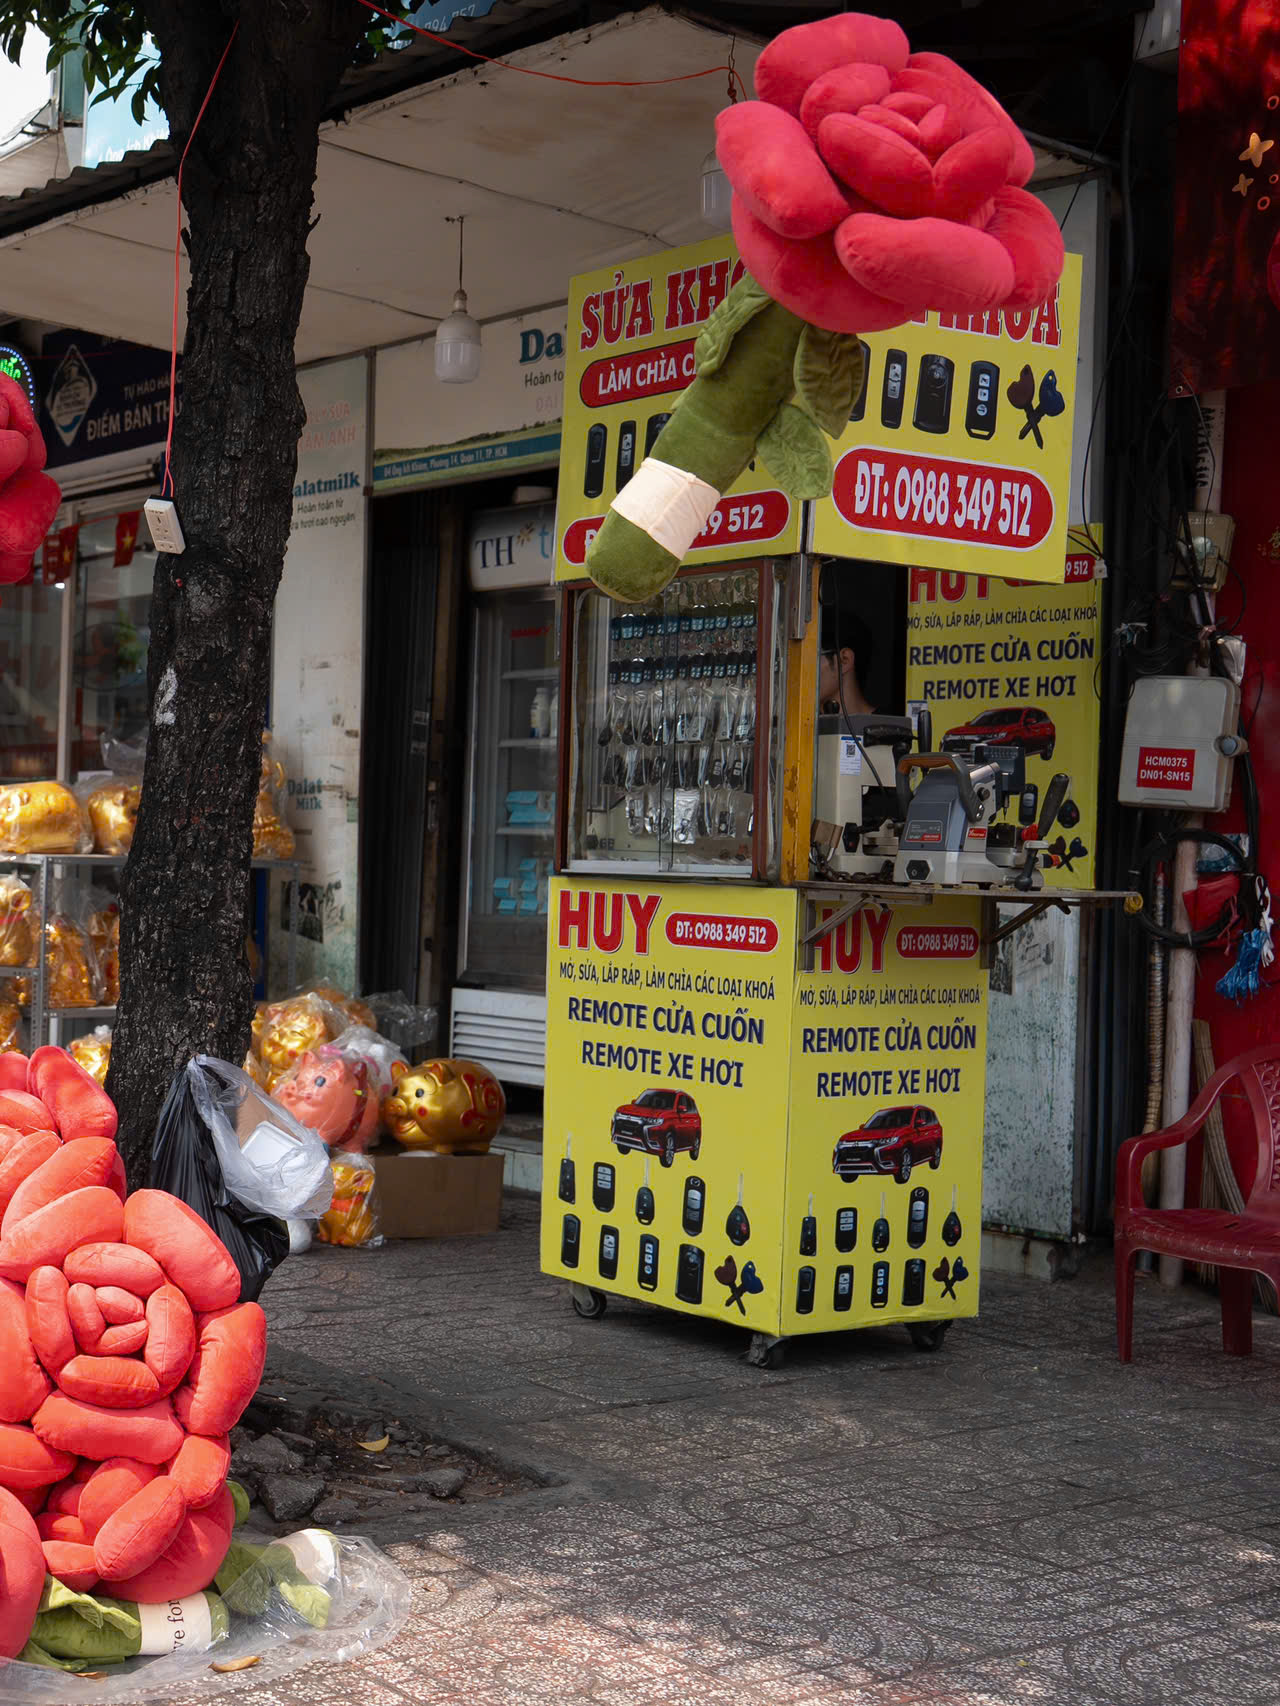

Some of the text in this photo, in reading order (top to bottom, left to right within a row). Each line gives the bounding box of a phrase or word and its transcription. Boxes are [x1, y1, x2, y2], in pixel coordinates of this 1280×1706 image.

[580, 270, 655, 352] SỬA
[157, 369, 183, 390] HÀG
[525, 370, 548, 387] Hoàn
[598, 352, 677, 396] LÀM CHÌA
[87, 402, 152, 441] ĐIỂM BÁN
[292, 471, 361, 499] alatmilk
[854, 460, 1033, 536] ĐT: 0988 349 512
[728, 504, 764, 533] 512
[475, 535, 516, 569] TH
[1074, 560, 1088, 576] 512
[985, 607, 1003, 625] LÀM
[1005, 606, 1027, 625] CHÌA
[1030, 606, 1047, 623] CÁC
[1049, 606, 1071, 624] LOẠI
[909, 632, 1094, 666] REMOTE CỬA CUỐN
[923, 675, 1077, 700] REMOTE XE HƠI
[1140, 769, 1190, 782] DN01-SN15
[1145, 755, 1188, 768] HCM0375
[558, 889, 768, 956] HUY ĐT: 0988 349 512
[901, 933, 916, 951] ĐT:
[917, 933, 940, 951] 0988
[942, 933, 959, 951] 349
[960, 933, 975, 951] 512
[622, 962, 643, 990] RÁP,
[646, 964, 665, 989] LÀM
[668, 967, 692, 992] CHÌA
[695, 969, 715, 994] CÁC
[717, 976, 742, 1001] LOẠI
[745, 975, 775, 1001] KHOÁ
[859, 984, 877, 1007] RÁP,
[879, 983, 896, 1004] LÀM
[898, 983, 918, 1004] CHÌA
[921, 983, 936, 1004] CÁC
[938, 988, 957, 1007] LOẠI
[959, 983, 981, 1004] KHOÁ
[568, 997, 765, 1045] REMOTE CỬA CUỐN
[802, 1016, 977, 1054] REMOTE CỬA CUỐN
[582, 1040, 744, 1088] REMOTE XE HƠI
[817, 1067, 960, 1098] REMOTE XE HƠI
